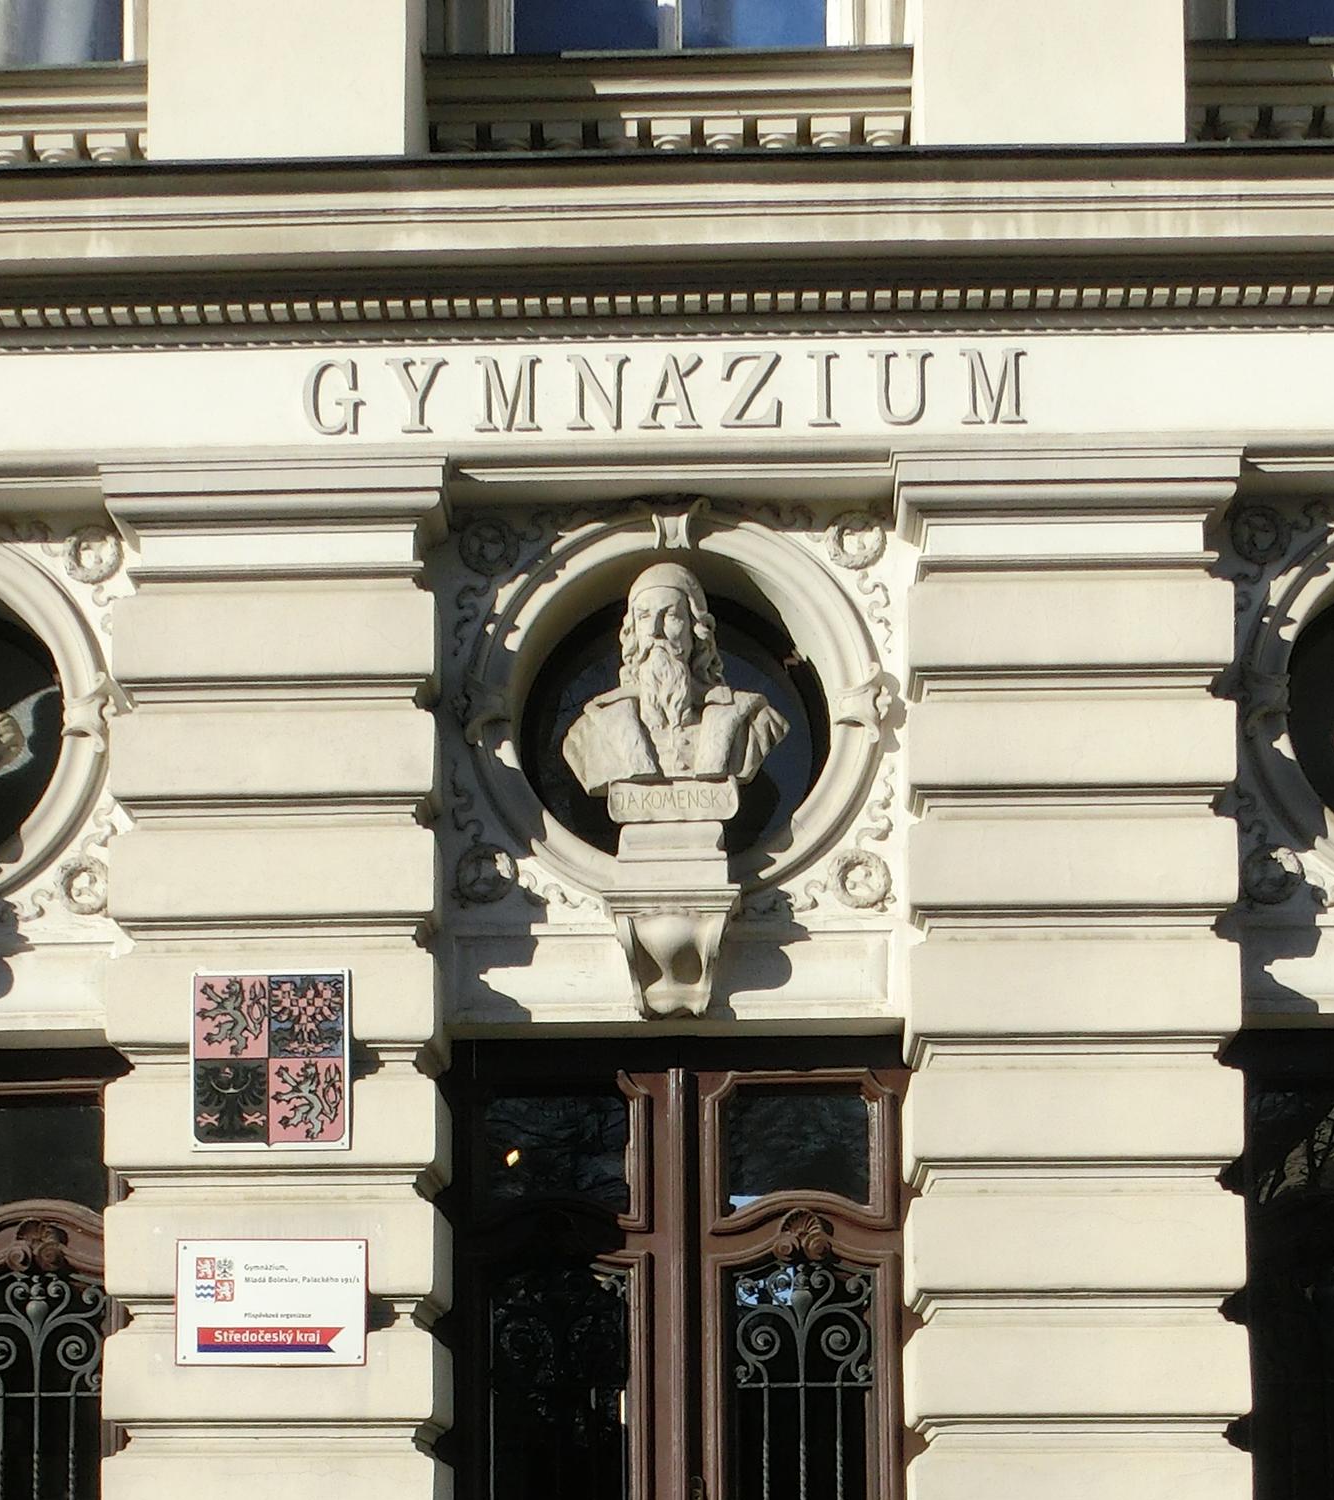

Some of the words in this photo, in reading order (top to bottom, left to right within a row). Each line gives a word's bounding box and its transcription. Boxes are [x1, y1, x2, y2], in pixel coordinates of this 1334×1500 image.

[301, 347, 1030, 436] GYMNÁZIUM
[244, 1275, 266, 1284] Mladá
[302, 1275, 339, 1284] Palackého
[213, 1329, 294, 1345] Středočeský
[296, 1329, 322, 1345] kraj
